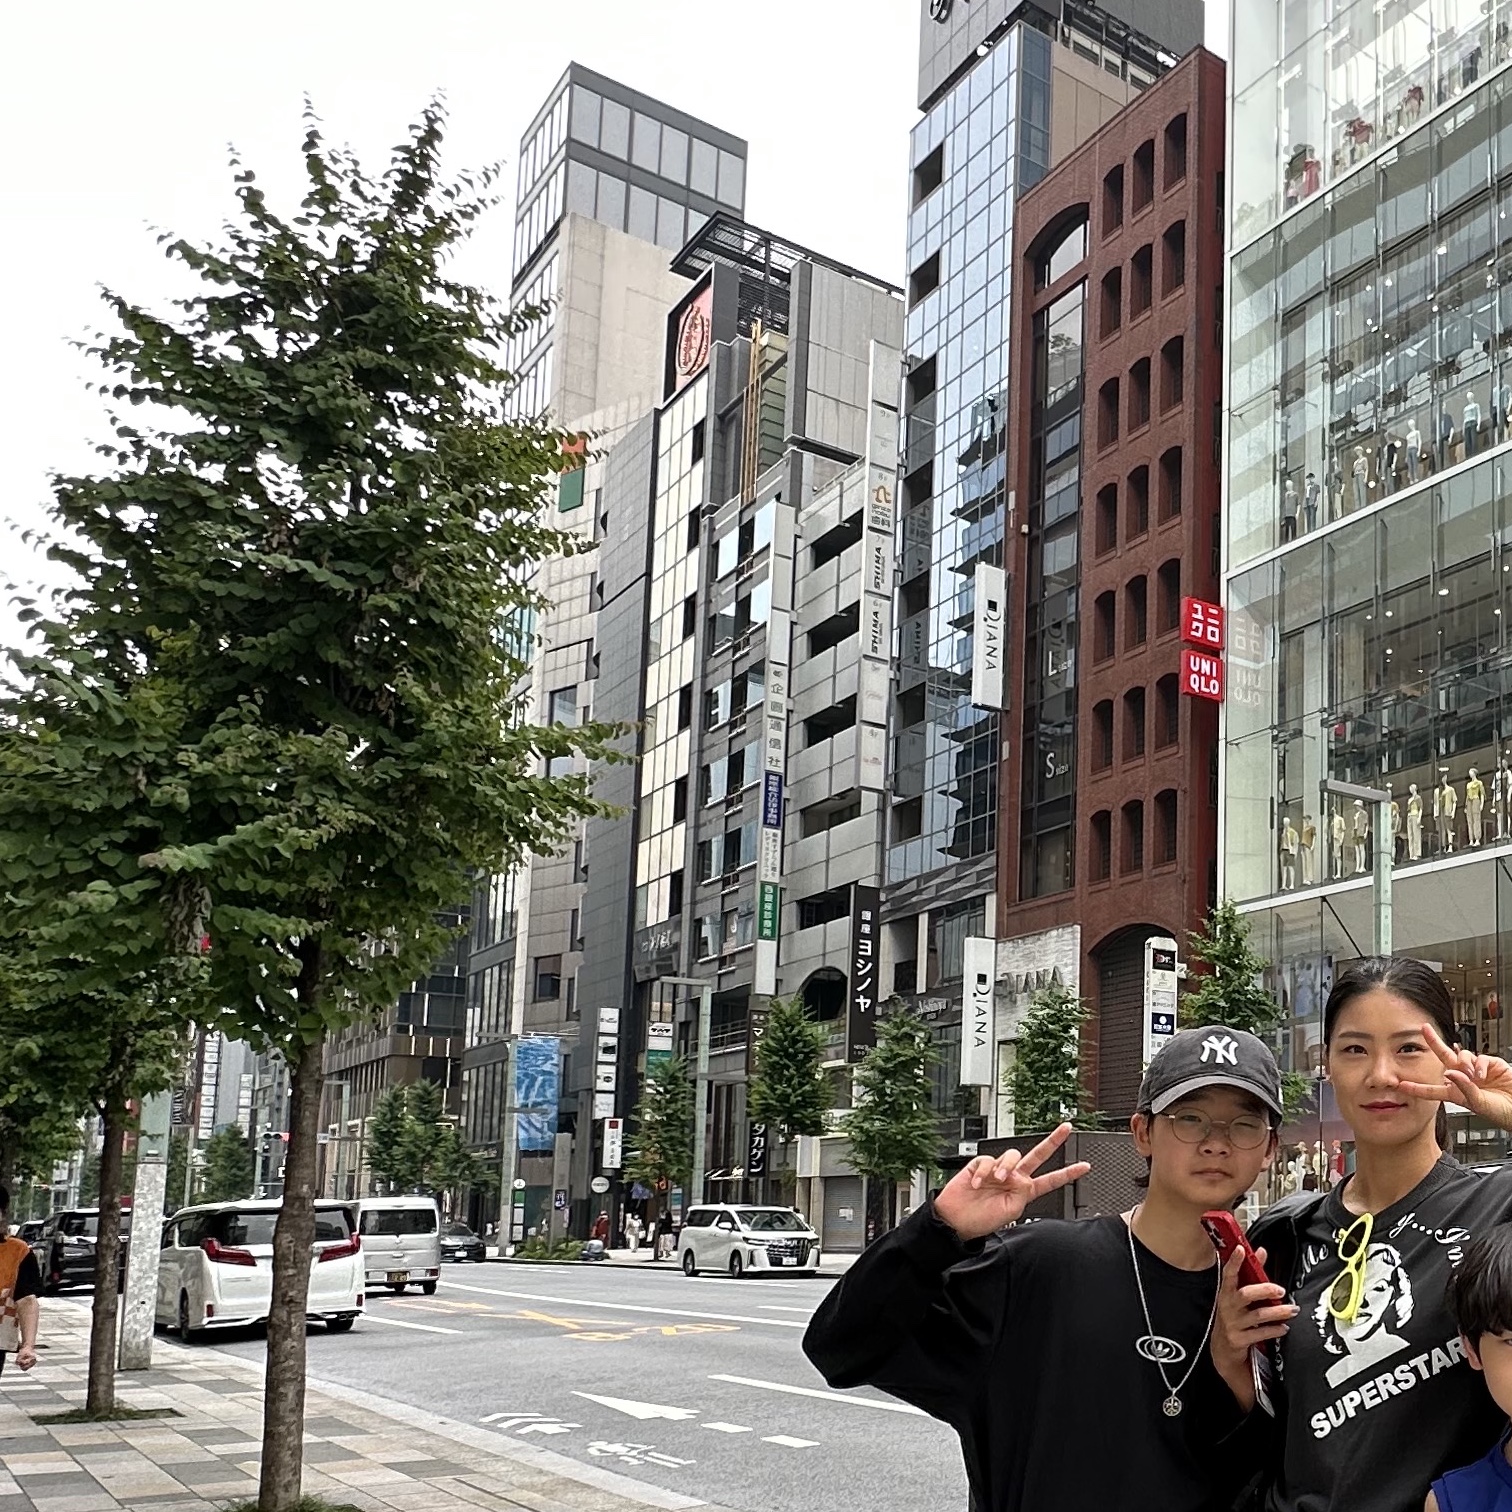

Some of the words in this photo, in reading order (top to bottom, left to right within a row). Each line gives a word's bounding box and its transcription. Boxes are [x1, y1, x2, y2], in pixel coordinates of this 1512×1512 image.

[871, 610, 880, 654] SHIMA
[1190, 654, 1217, 678] UNI
[1190, 674, 1219, 695] QLO
[973, 974, 991, 1047] DIANA
[1199, 1034, 1239, 1067] NY
[750, 1123, 766, 1173] タカゲン
[1310, 1336, 1468, 1440] SUPERSTAR
